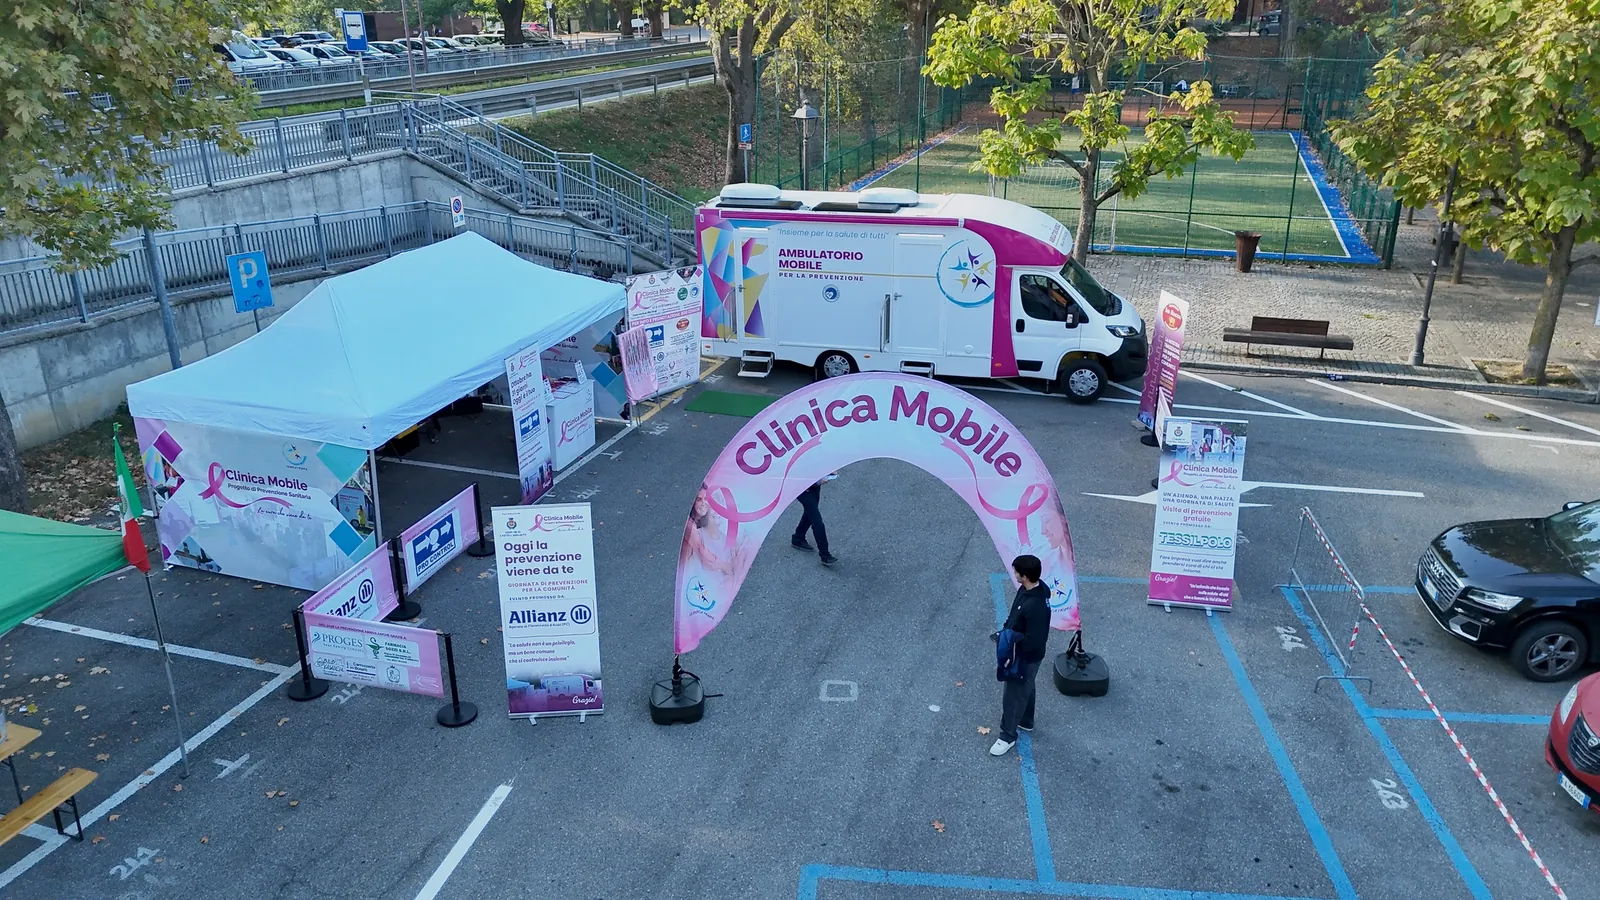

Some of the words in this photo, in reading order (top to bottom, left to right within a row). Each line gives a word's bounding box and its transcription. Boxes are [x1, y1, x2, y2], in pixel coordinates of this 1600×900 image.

[826, 229, 833, 237] la
[835, 230, 858, 238] salute
[779, 249, 863, 260] AMBULATORIO
[779, 260, 822, 270] MOBILE
[238, 258, 258, 288] P
[735, 394, 878, 475] Clinica
[889, 385, 1022, 477] Mobile
[1183, 464, 1210, 473] Clinica
[1211, 466, 1238, 474] Mobile
[226, 469, 265, 485] Clinica
[267, 475, 308, 491] Mobile
[228, 483, 250, 491] Progetto
[257, 487, 287, 497] Prevenzione
[289, 492, 312, 500] Sanitaria
[1163, 492, 1199, 500] UN'AZIENDA,
[1191, 509, 1232, 517] prevenzione
[504, 540, 534, 554] Oggi
[536, 540, 548, 550] la
[1159, 531, 1232, 549] TESSILPOLO
[417, 561, 429, 572] PRO
[429, 541, 454, 562] CONTROL
[505, 552, 582, 567] prevenzione
[506, 568, 540, 576] viene
[543, 566, 559, 575] da
[562, 565, 574, 574] te
[1154, 573, 1178, 583] Grazie!
[509, 610, 567, 624] Allianz
[322, 633, 363, 648] PROGES
[572, 695, 597, 705] Grazie!
[1370, 779, 1409, 809] 263
